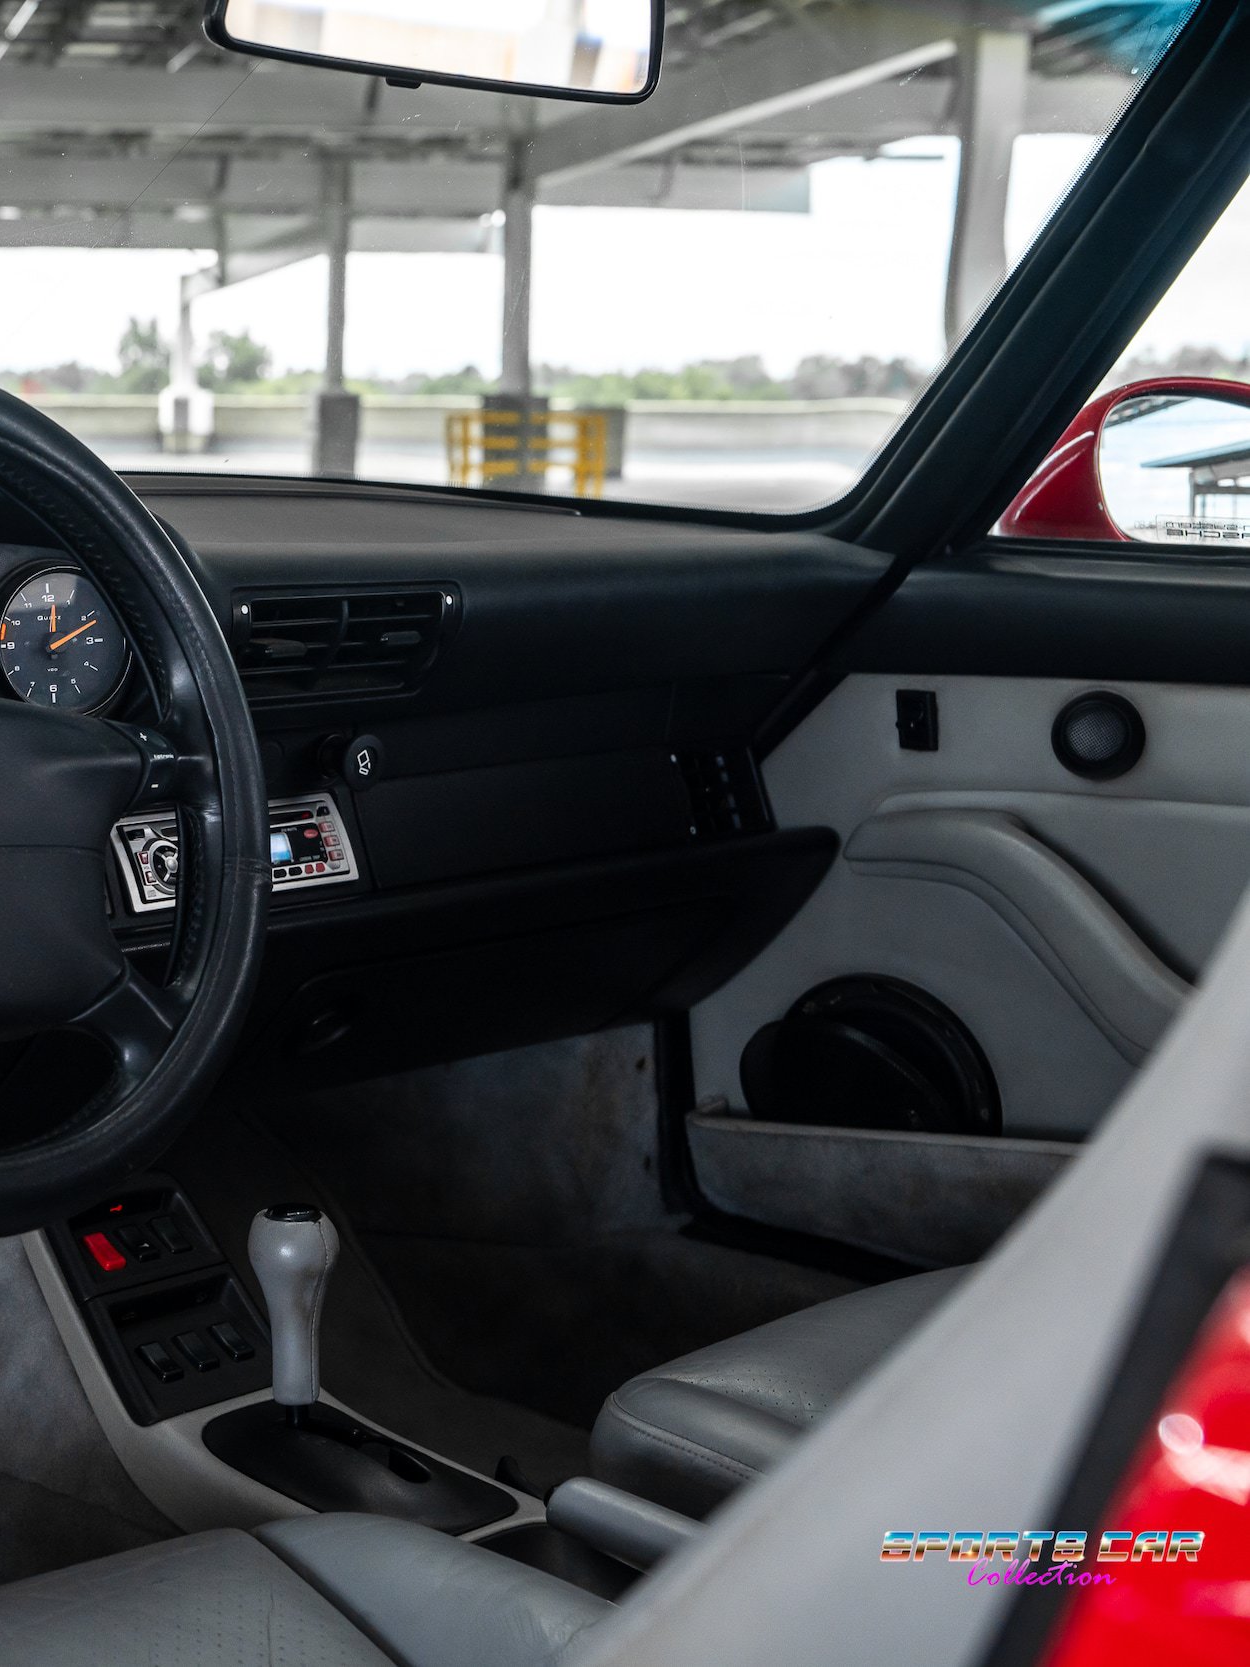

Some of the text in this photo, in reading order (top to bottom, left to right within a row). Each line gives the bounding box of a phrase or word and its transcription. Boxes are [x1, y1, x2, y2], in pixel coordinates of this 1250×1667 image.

[41, 594, 55, 602] 12
[86, 637, 94, 645] 3
[6, 642, 15, 650] 9
[49, 684, 58, 692] 6
